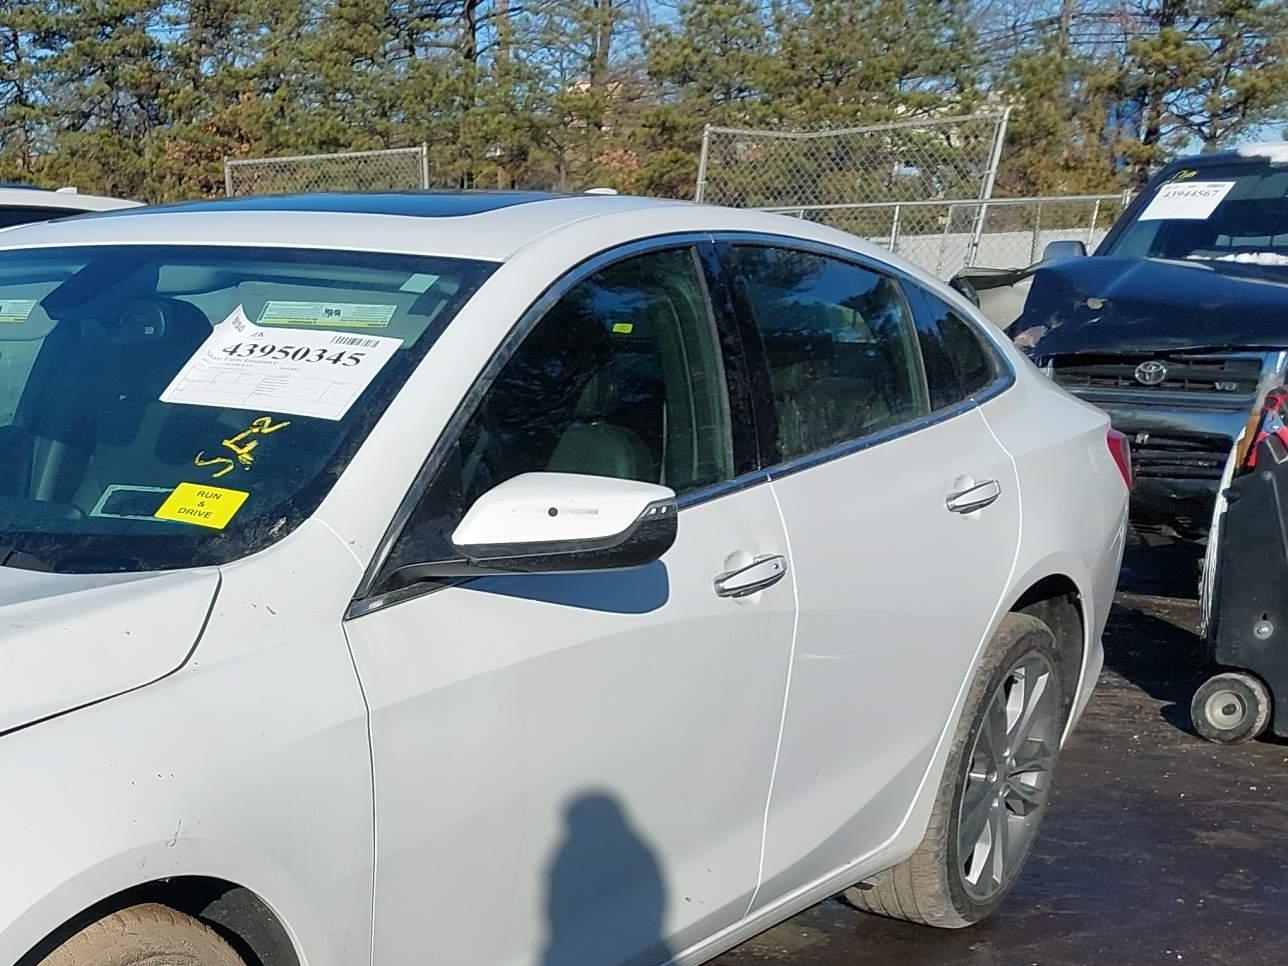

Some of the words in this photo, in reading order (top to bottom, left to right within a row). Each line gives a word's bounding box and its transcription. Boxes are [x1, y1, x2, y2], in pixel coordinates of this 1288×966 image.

[221, 342, 367, 367] 43950345
[197, 490, 222, 500] RUN
[177, 507, 214, 519] DRIVE
